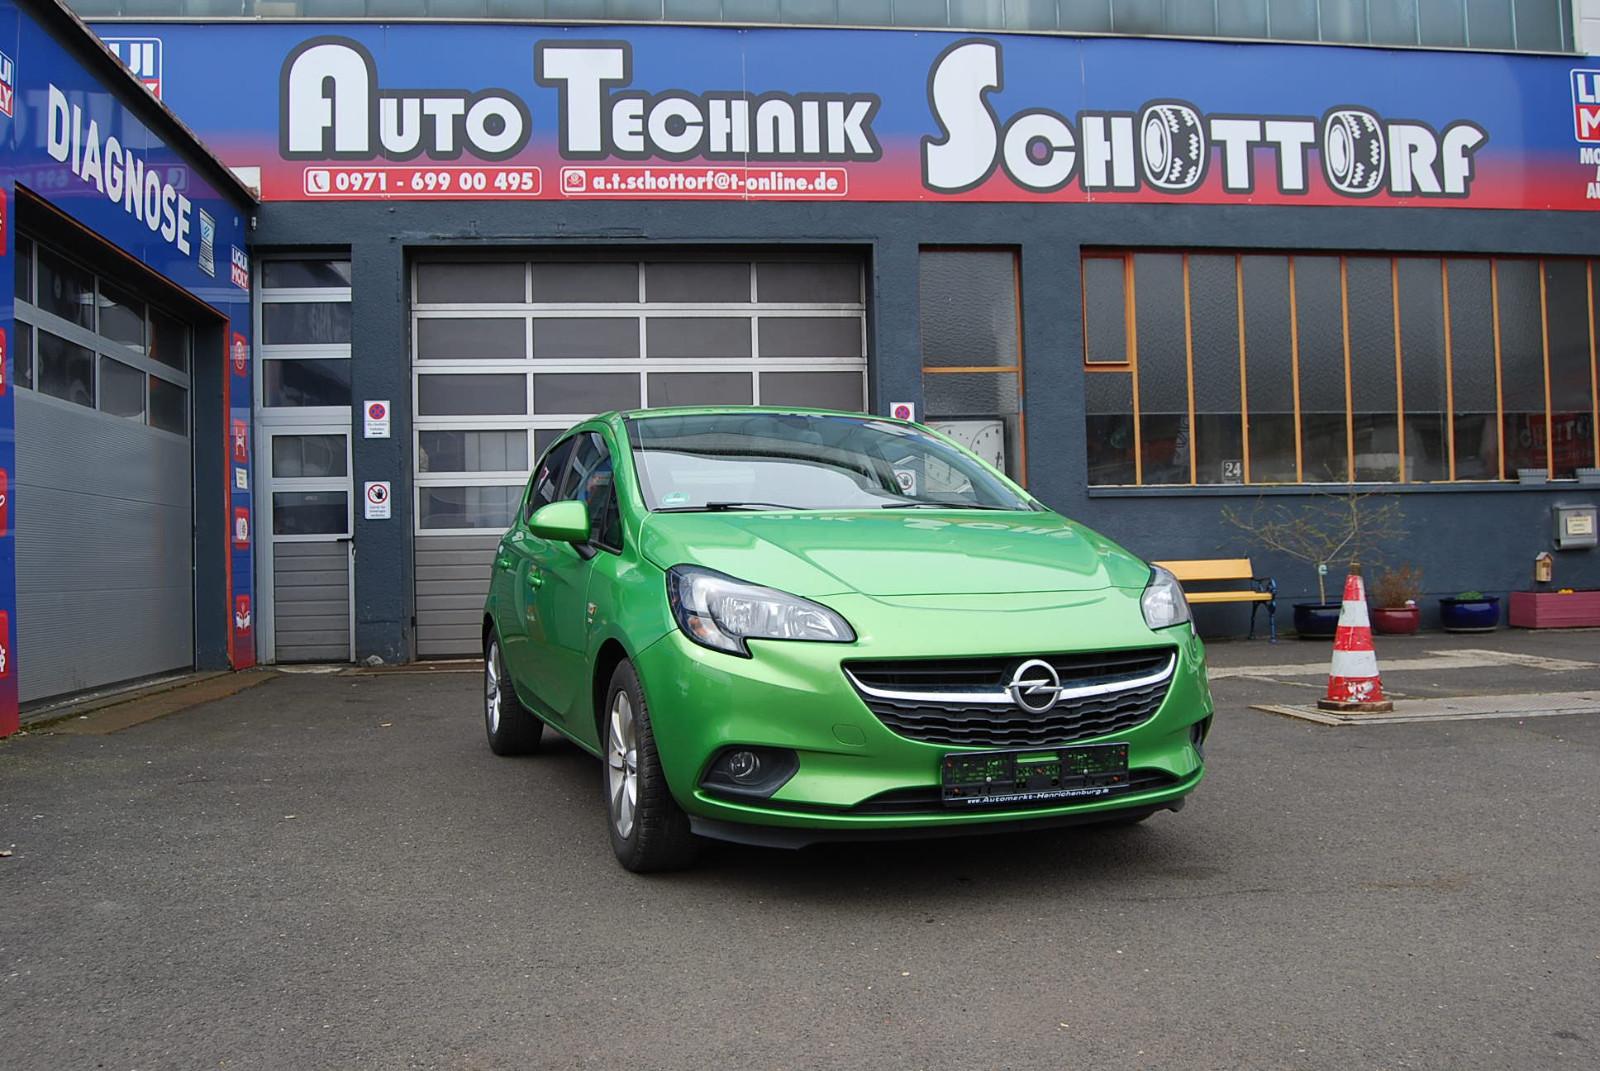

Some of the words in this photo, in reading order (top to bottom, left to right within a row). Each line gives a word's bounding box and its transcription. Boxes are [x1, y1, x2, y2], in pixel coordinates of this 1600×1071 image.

[47, 83, 191, 256] DIAGNOSE
[335, 170, 388, 191] 0971
[410, 171, 452, 191] 699
[458, 171, 488, 191] 00
[493, 171, 534, 192] 495
[592, 170, 839, 192] a.t.schottorf@t-online.de
[1225, 462, 1241, 477] 24
